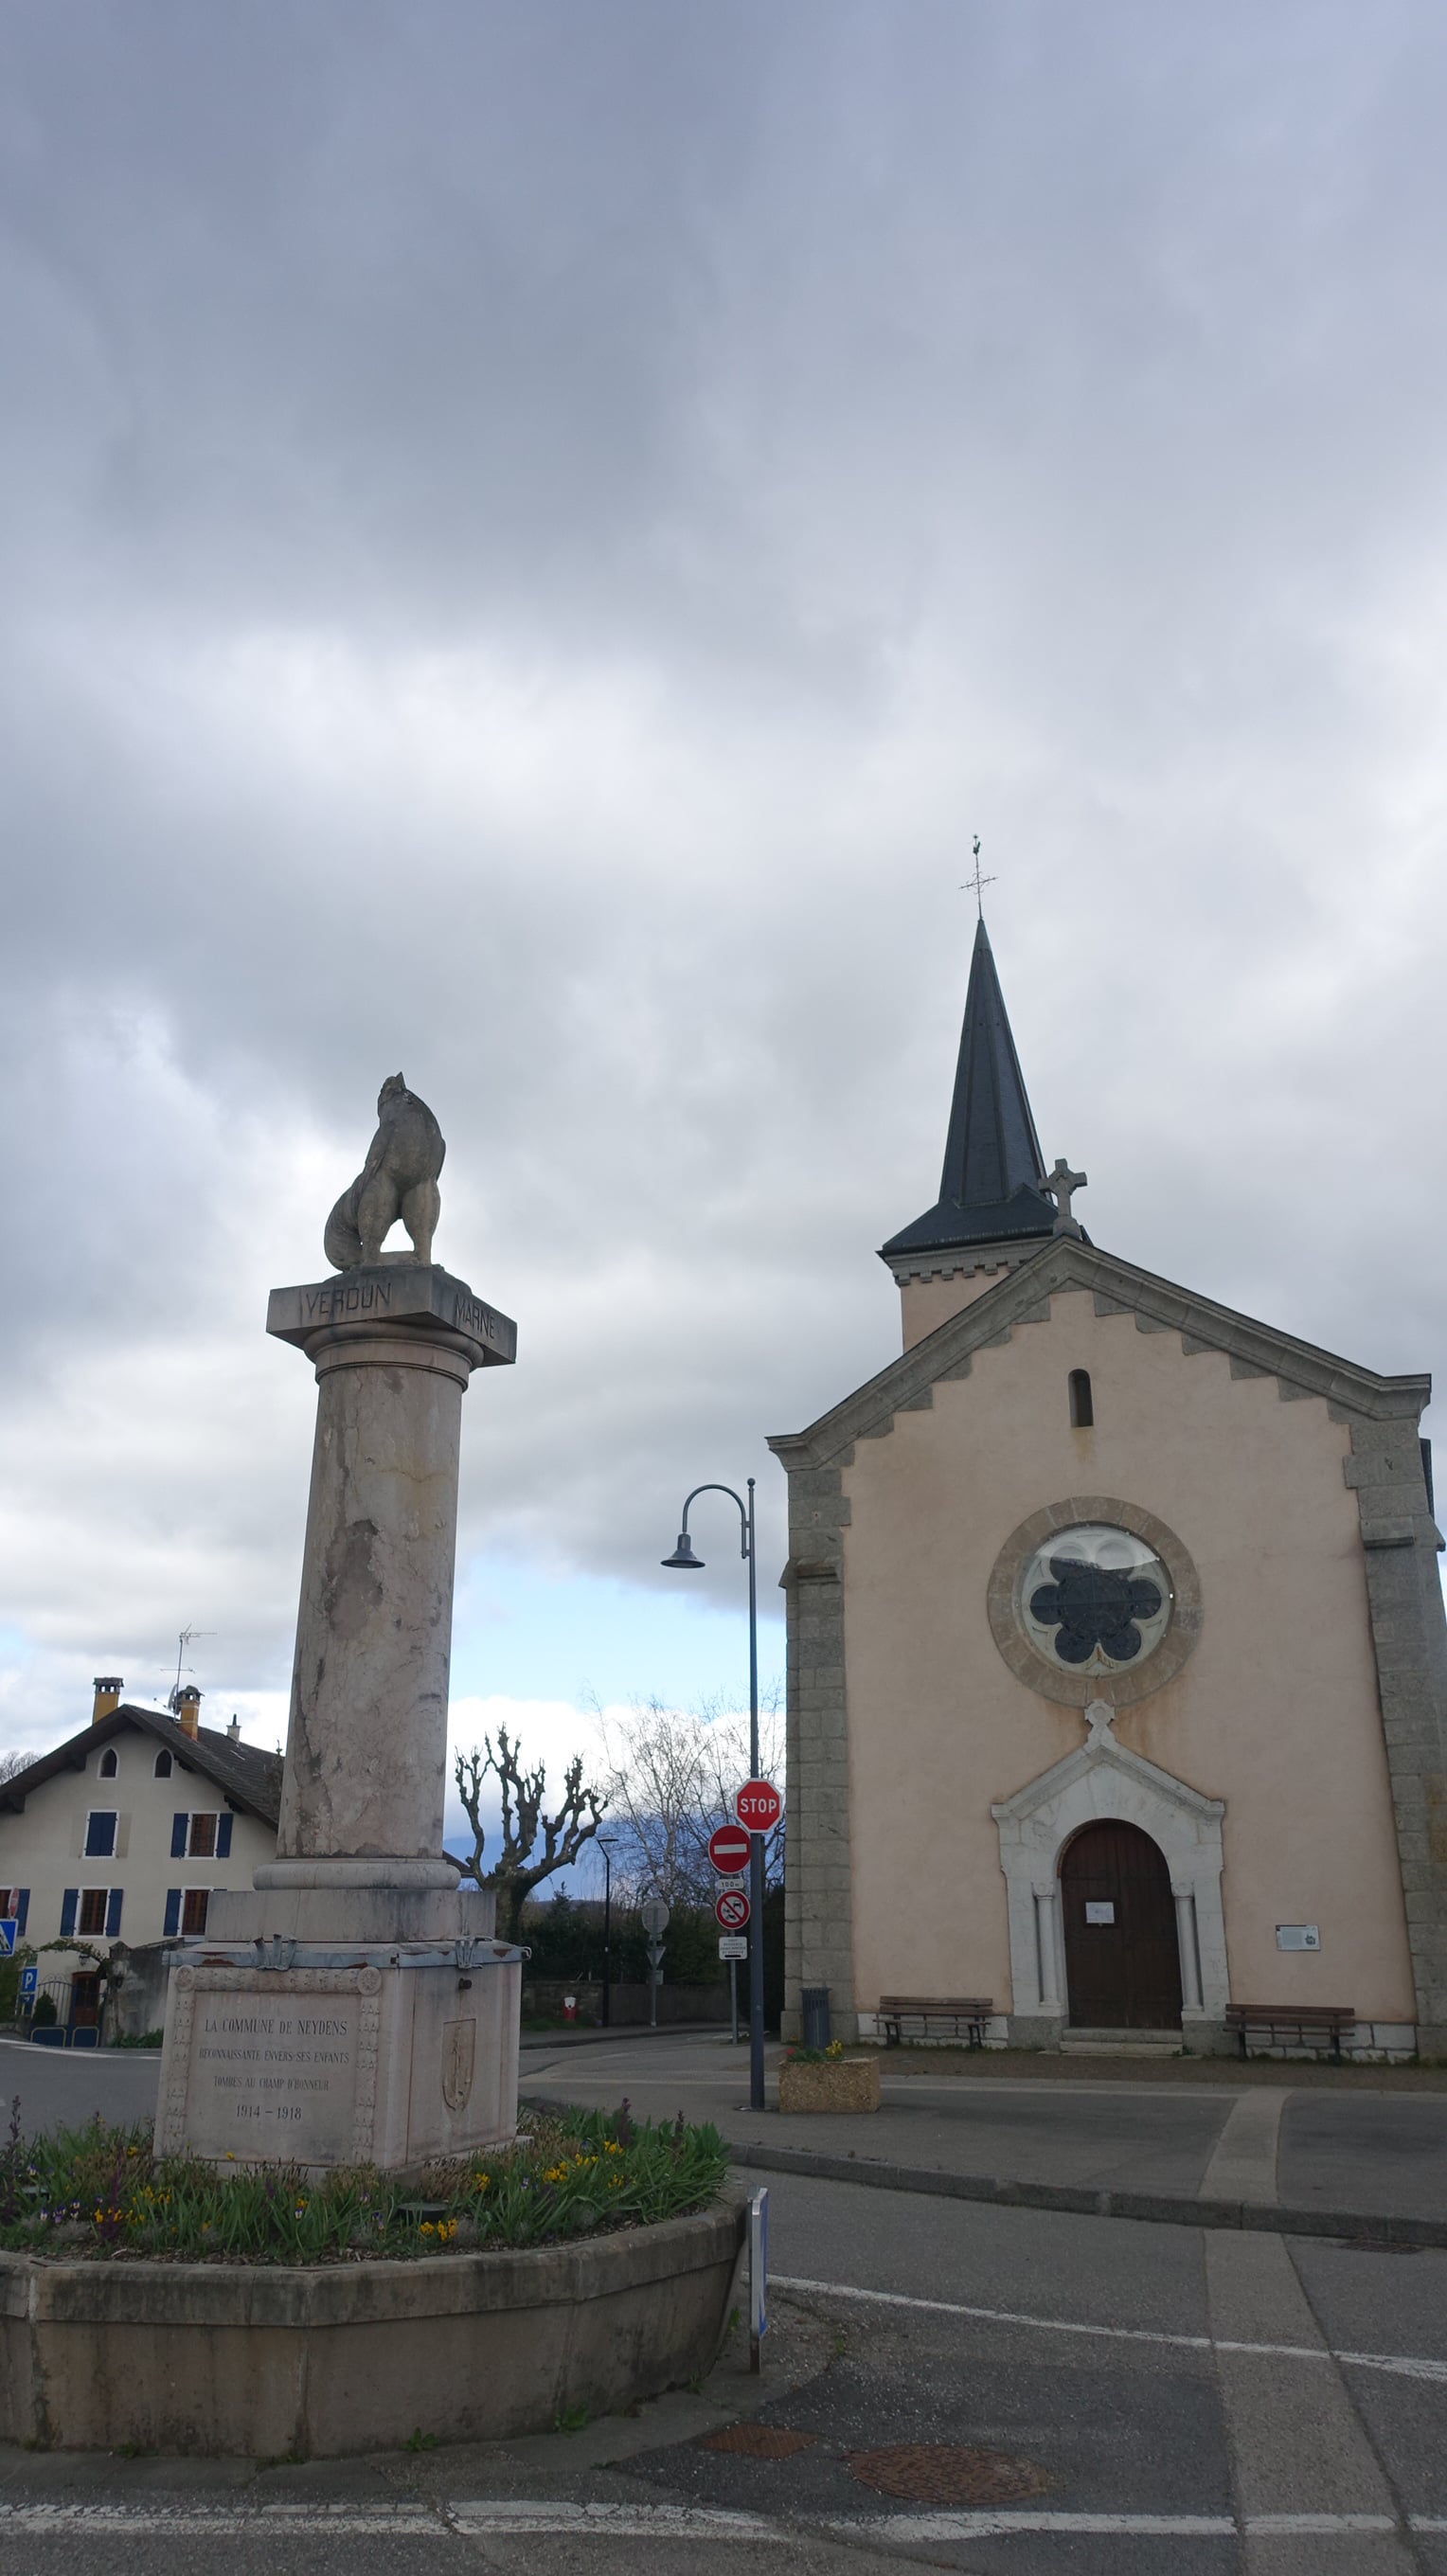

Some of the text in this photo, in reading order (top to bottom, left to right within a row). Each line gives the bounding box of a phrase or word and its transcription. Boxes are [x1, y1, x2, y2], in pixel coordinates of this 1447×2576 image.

[305, 1282, 392, 1317] VERDUN
[454, 1294, 495, 1339] MARNE
[740, 1798, 777, 1814] STOP
[26, 1972, 33, 1989] P
[205, 2018, 348, 2036] LA COMMUNE DE NEYDENS
[199, 2048, 349, 2064] RECONNAISSANTE ENVERS SES ENFANTS
[245, 2077, 256, 2088] AU
[259, 2077, 285, 2089] CHAMP
[287, 2078, 330, 2091] D'HONNEUR
[237, 2104, 260, 2118] 1914
[277, 2106, 302, 2120] 1918
